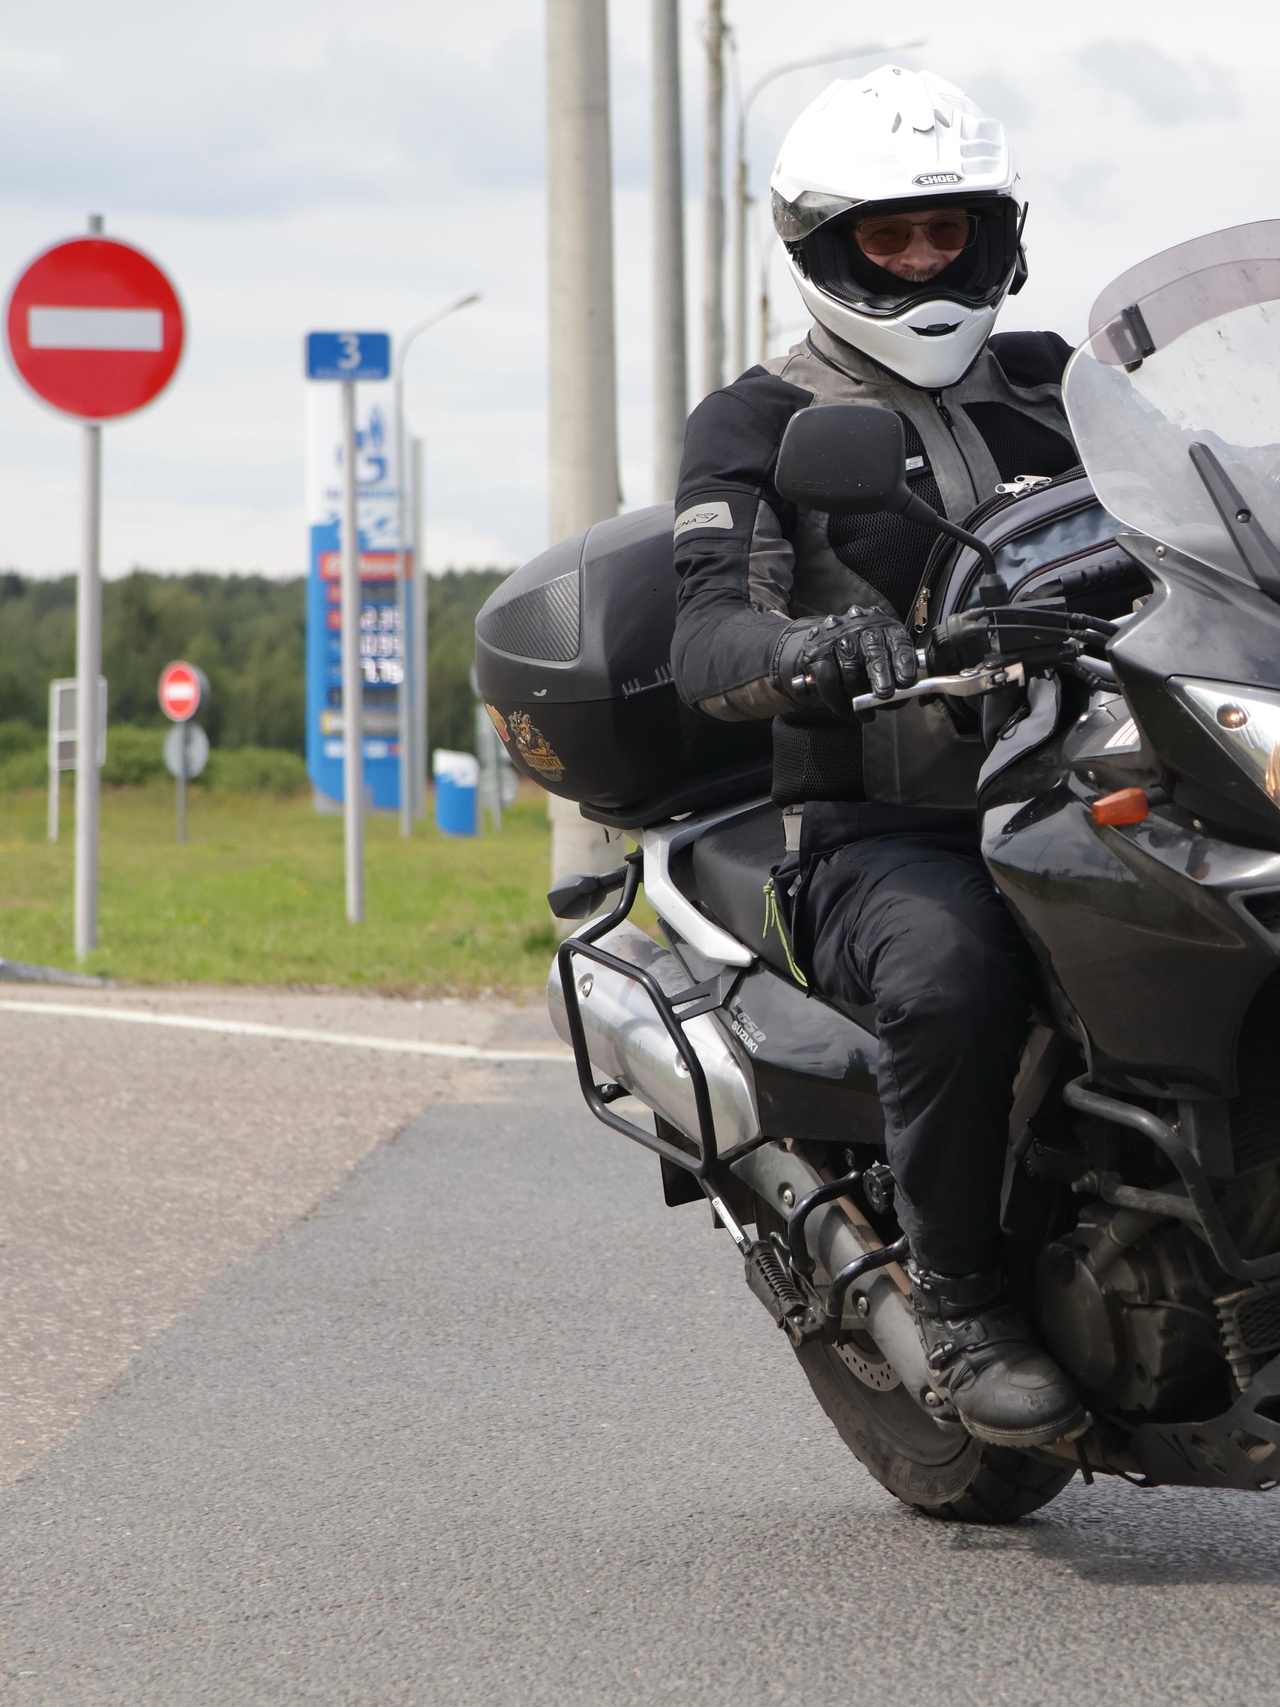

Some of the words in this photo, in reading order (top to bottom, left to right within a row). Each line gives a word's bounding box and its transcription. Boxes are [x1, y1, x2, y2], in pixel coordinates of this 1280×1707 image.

[919, 174, 959, 185] SHOEI
[337, 334, 361, 370] 3
[731, 1020, 758, 1053] SUZUKI
